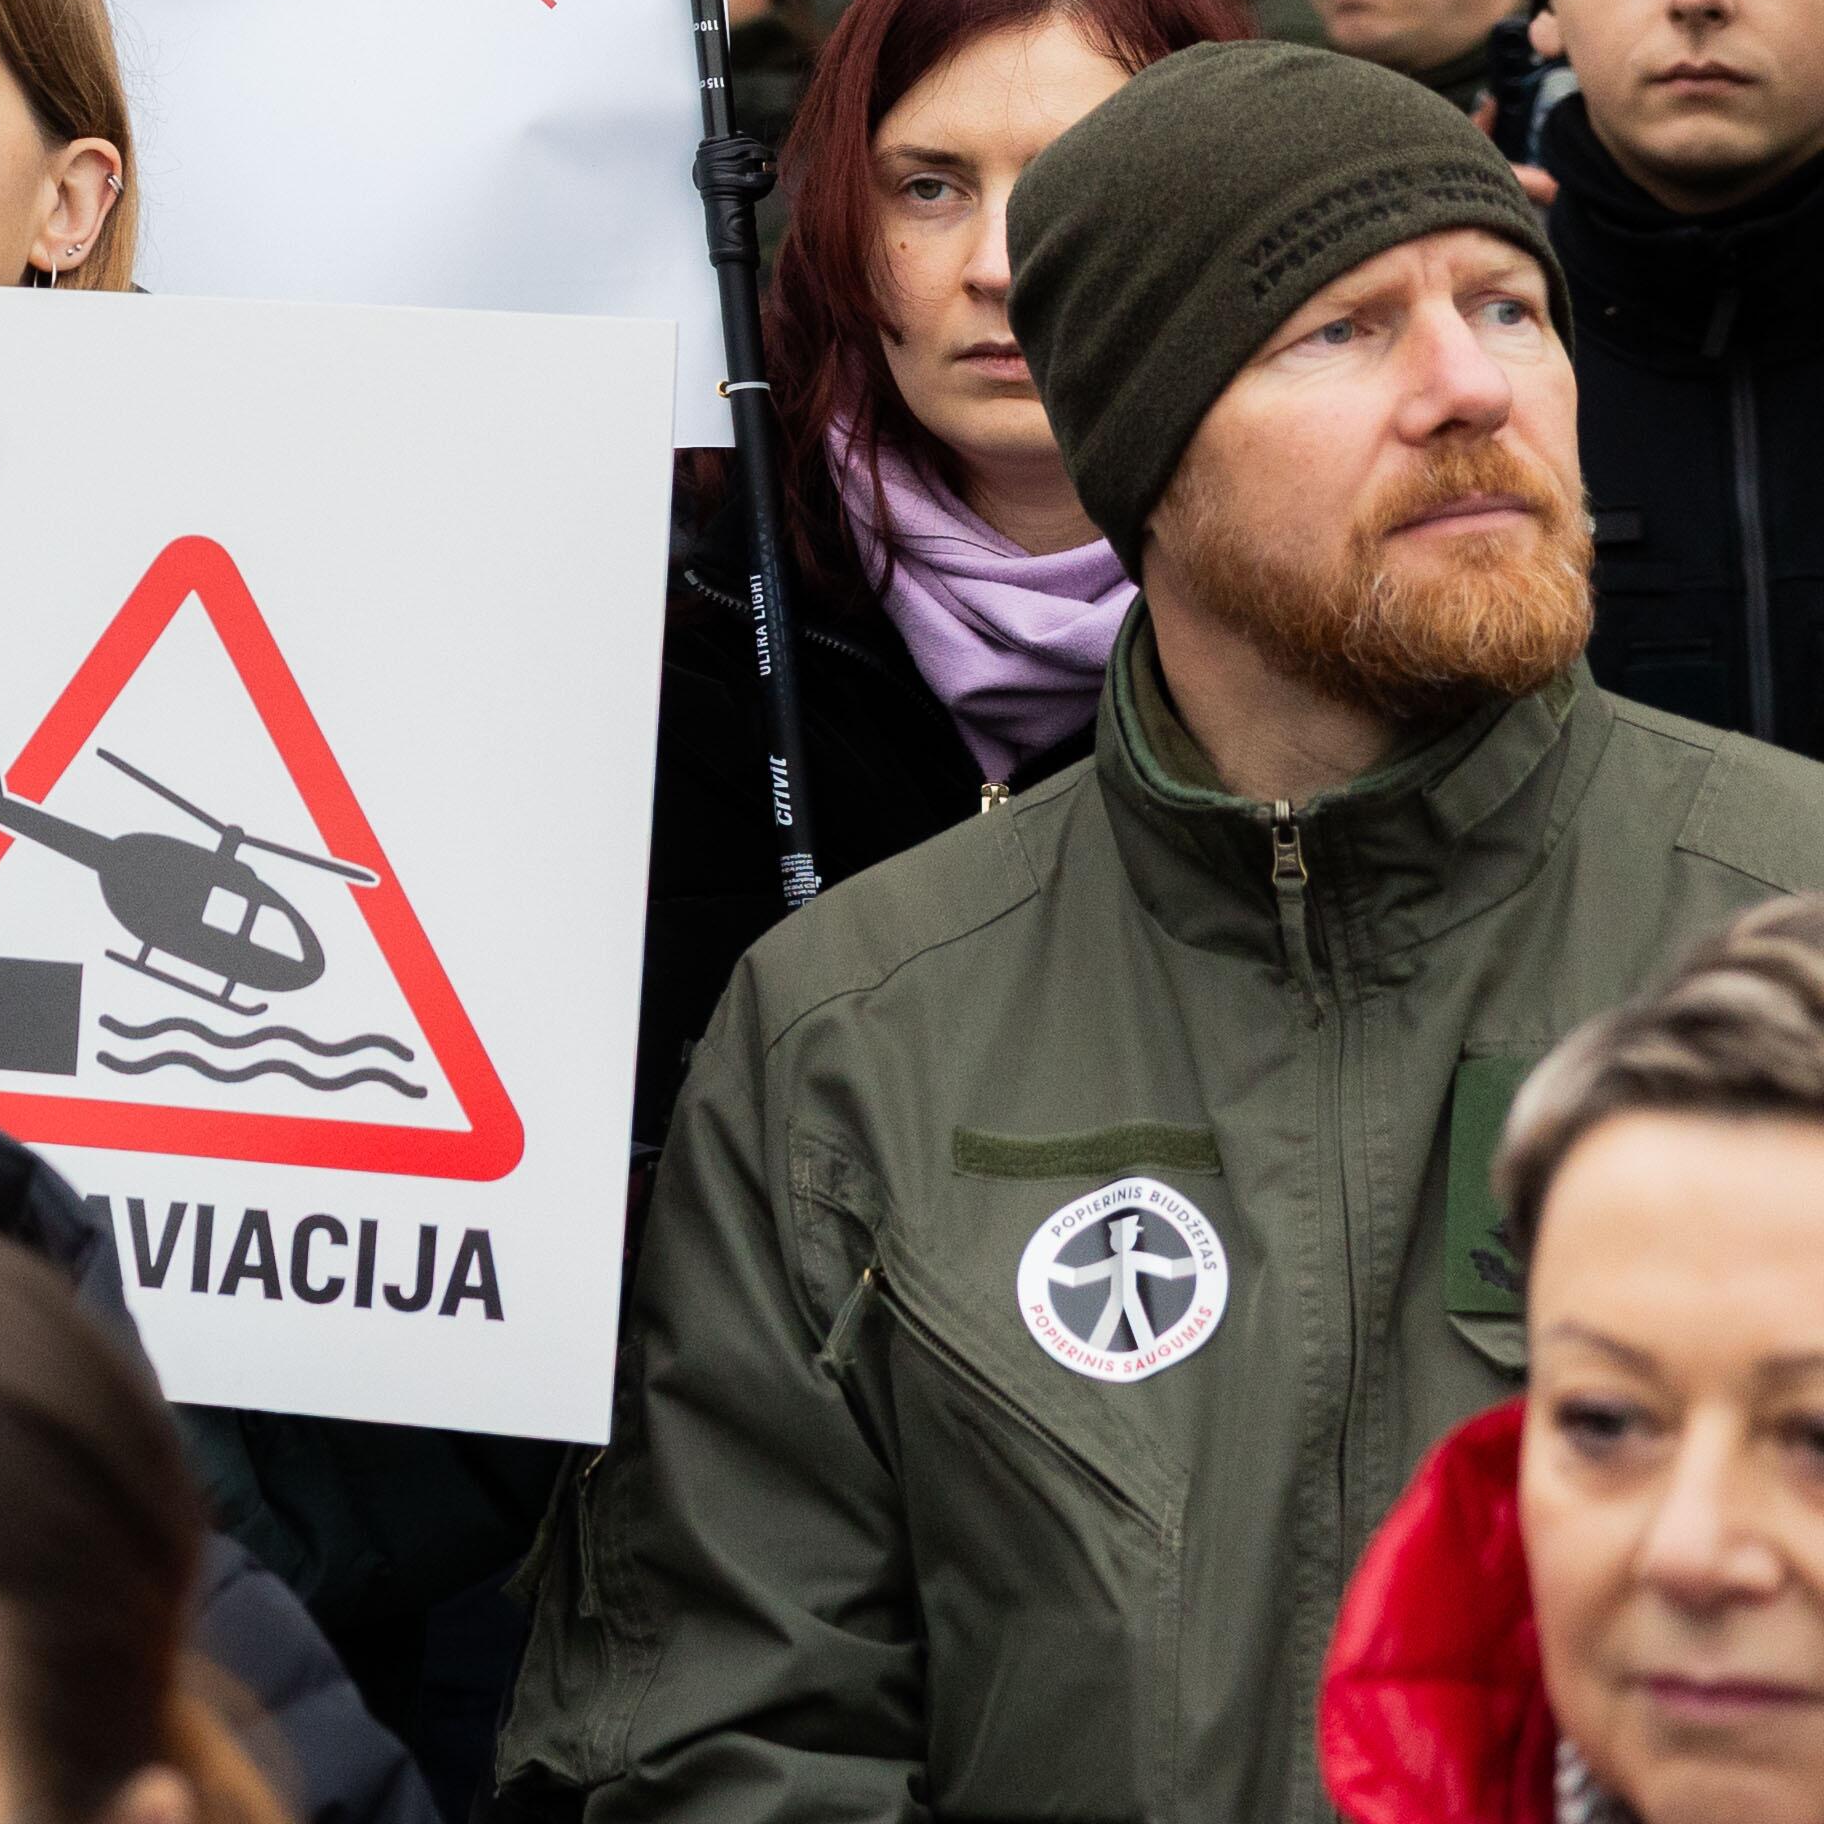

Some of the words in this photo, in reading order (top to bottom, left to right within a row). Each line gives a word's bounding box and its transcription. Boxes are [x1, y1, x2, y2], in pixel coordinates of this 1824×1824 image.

[749, 574, 766, 621] LIGHT
[759, 624, 772, 676] ULTRA
[1051, 1185, 1143, 1238] POPIERINIS
[1148, 1189, 1218, 1272] BIUDŽETAS
[1029, 1303, 1115, 1373] POPIERINIS
[1123, 1305, 1214, 1374] SAUGUMAS
